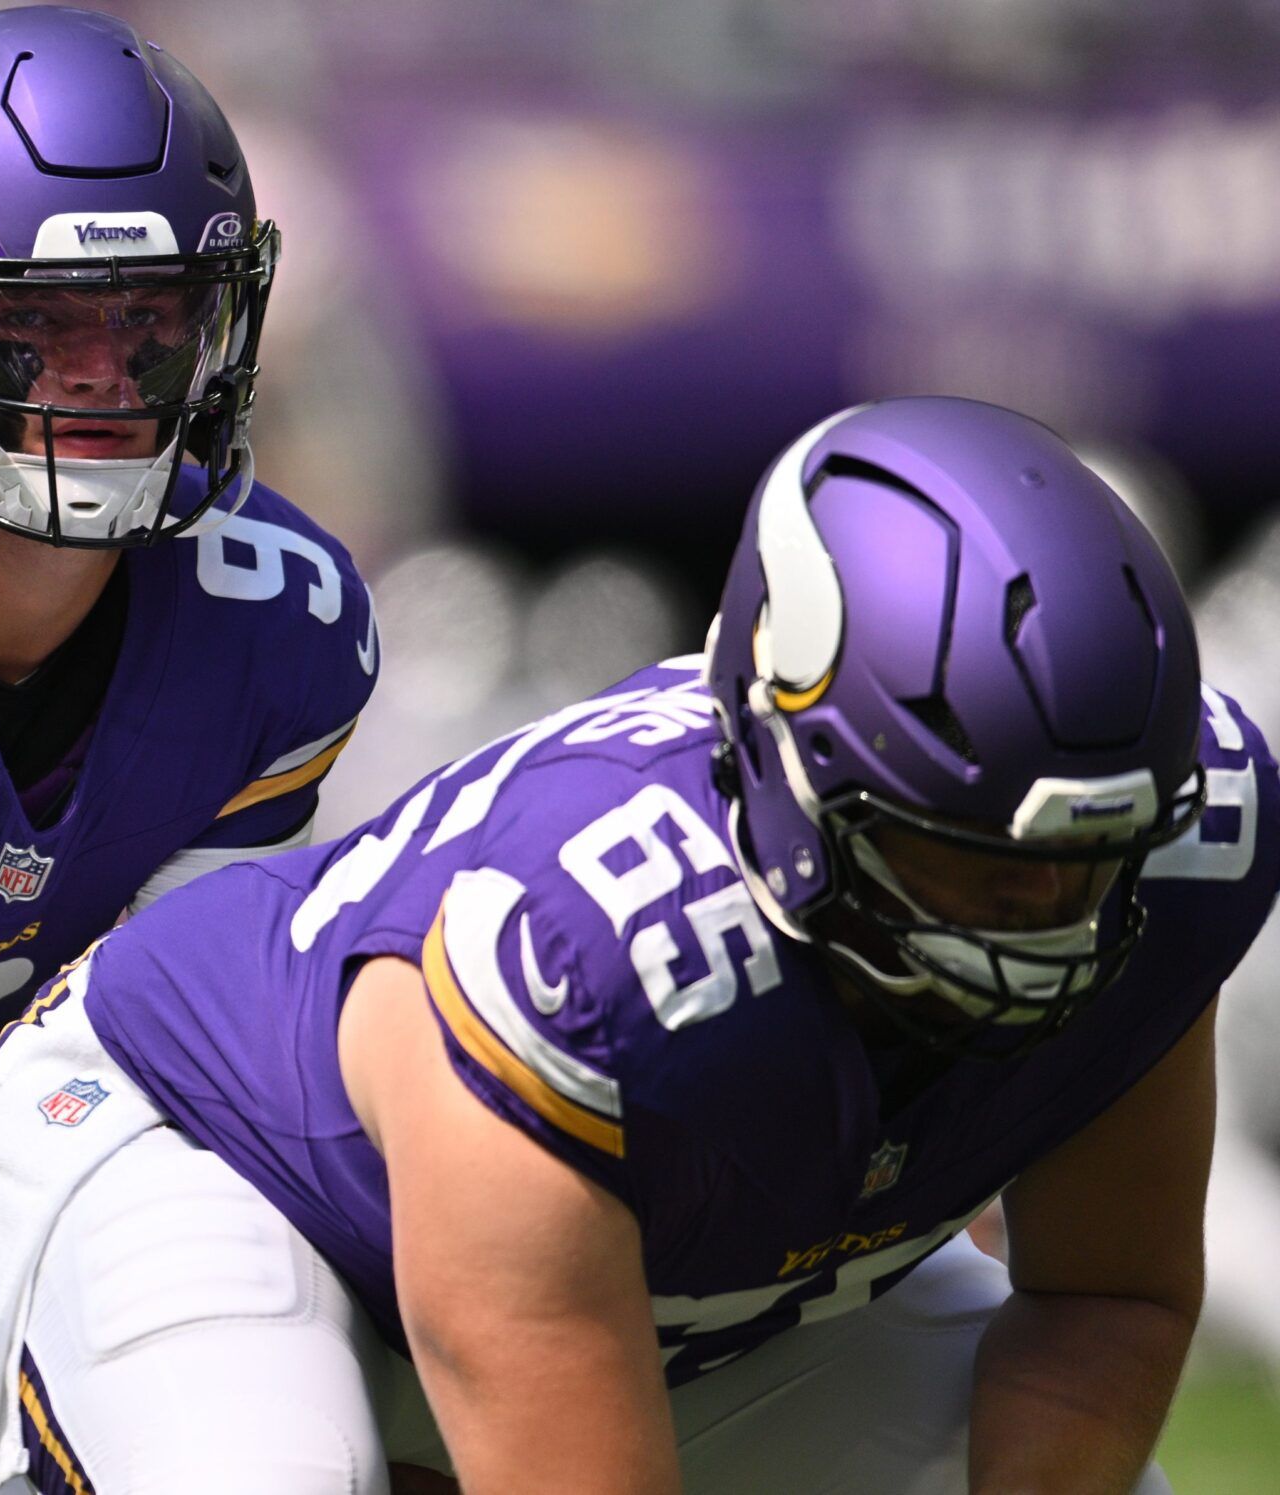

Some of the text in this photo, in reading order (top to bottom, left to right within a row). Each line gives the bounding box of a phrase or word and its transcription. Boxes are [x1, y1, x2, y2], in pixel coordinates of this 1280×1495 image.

[197, 507, 341, 624] 9
[558, 784, 783, 1031] 65
[43, 1092, 87, 1124] NFL
